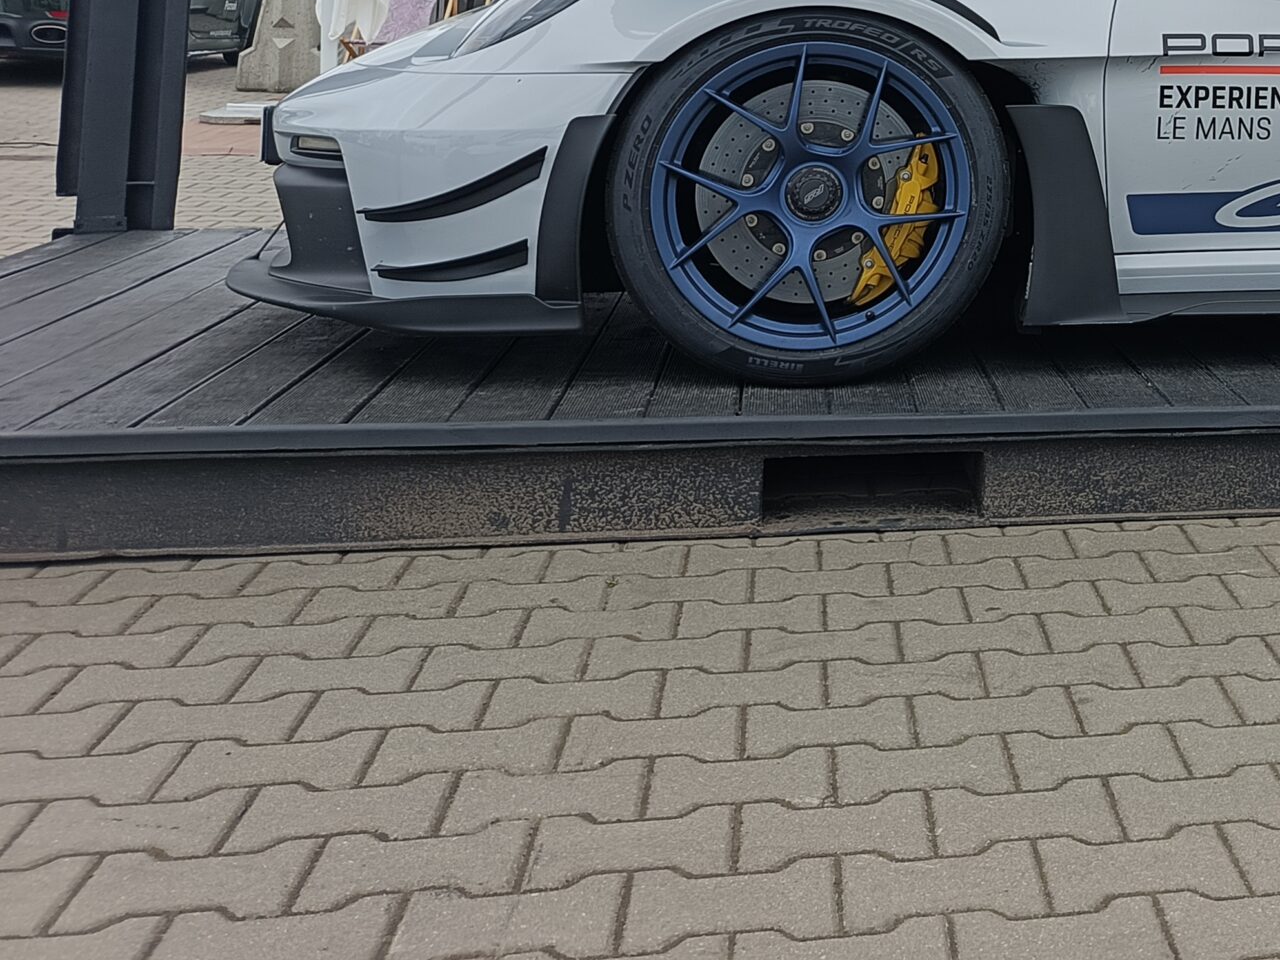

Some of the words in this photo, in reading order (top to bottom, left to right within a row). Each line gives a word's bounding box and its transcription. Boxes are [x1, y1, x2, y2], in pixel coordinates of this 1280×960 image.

[803, 18, 901, 44] TROFEO
[909, 47, 943, 72] RS
[1156, 116, 1187, 141] LE
[1195, 116, 1272, 141] MANS
[624, 113, 653, 190] ZERO
[622, 192, 632, 213] P
